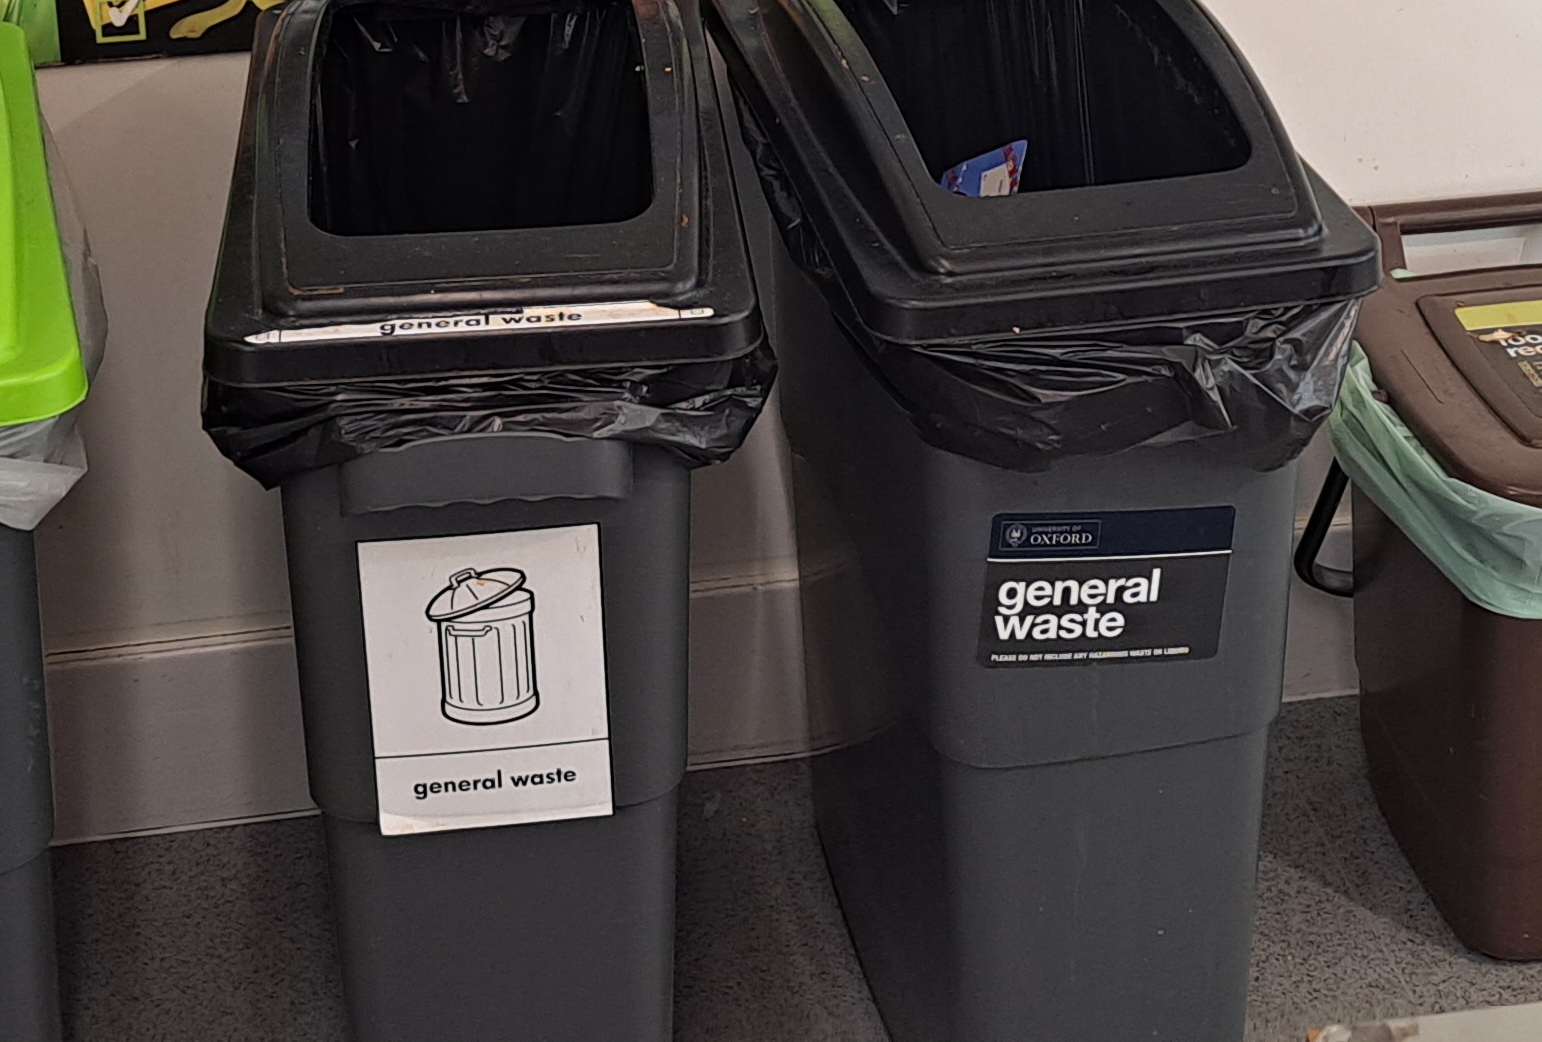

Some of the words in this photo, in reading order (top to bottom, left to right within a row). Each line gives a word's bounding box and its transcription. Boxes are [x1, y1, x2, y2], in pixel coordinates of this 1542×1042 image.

[380, 314, 489, 336] general
[502, 311, 582, 324] waste
[1030, 533, 1092, 545] OXFORD
[998, 568, 1161, 614] general
[995, 607, 1125, 640] waste
[413, 771, 502, 799] general
[510, 767, 576, 785] waste
